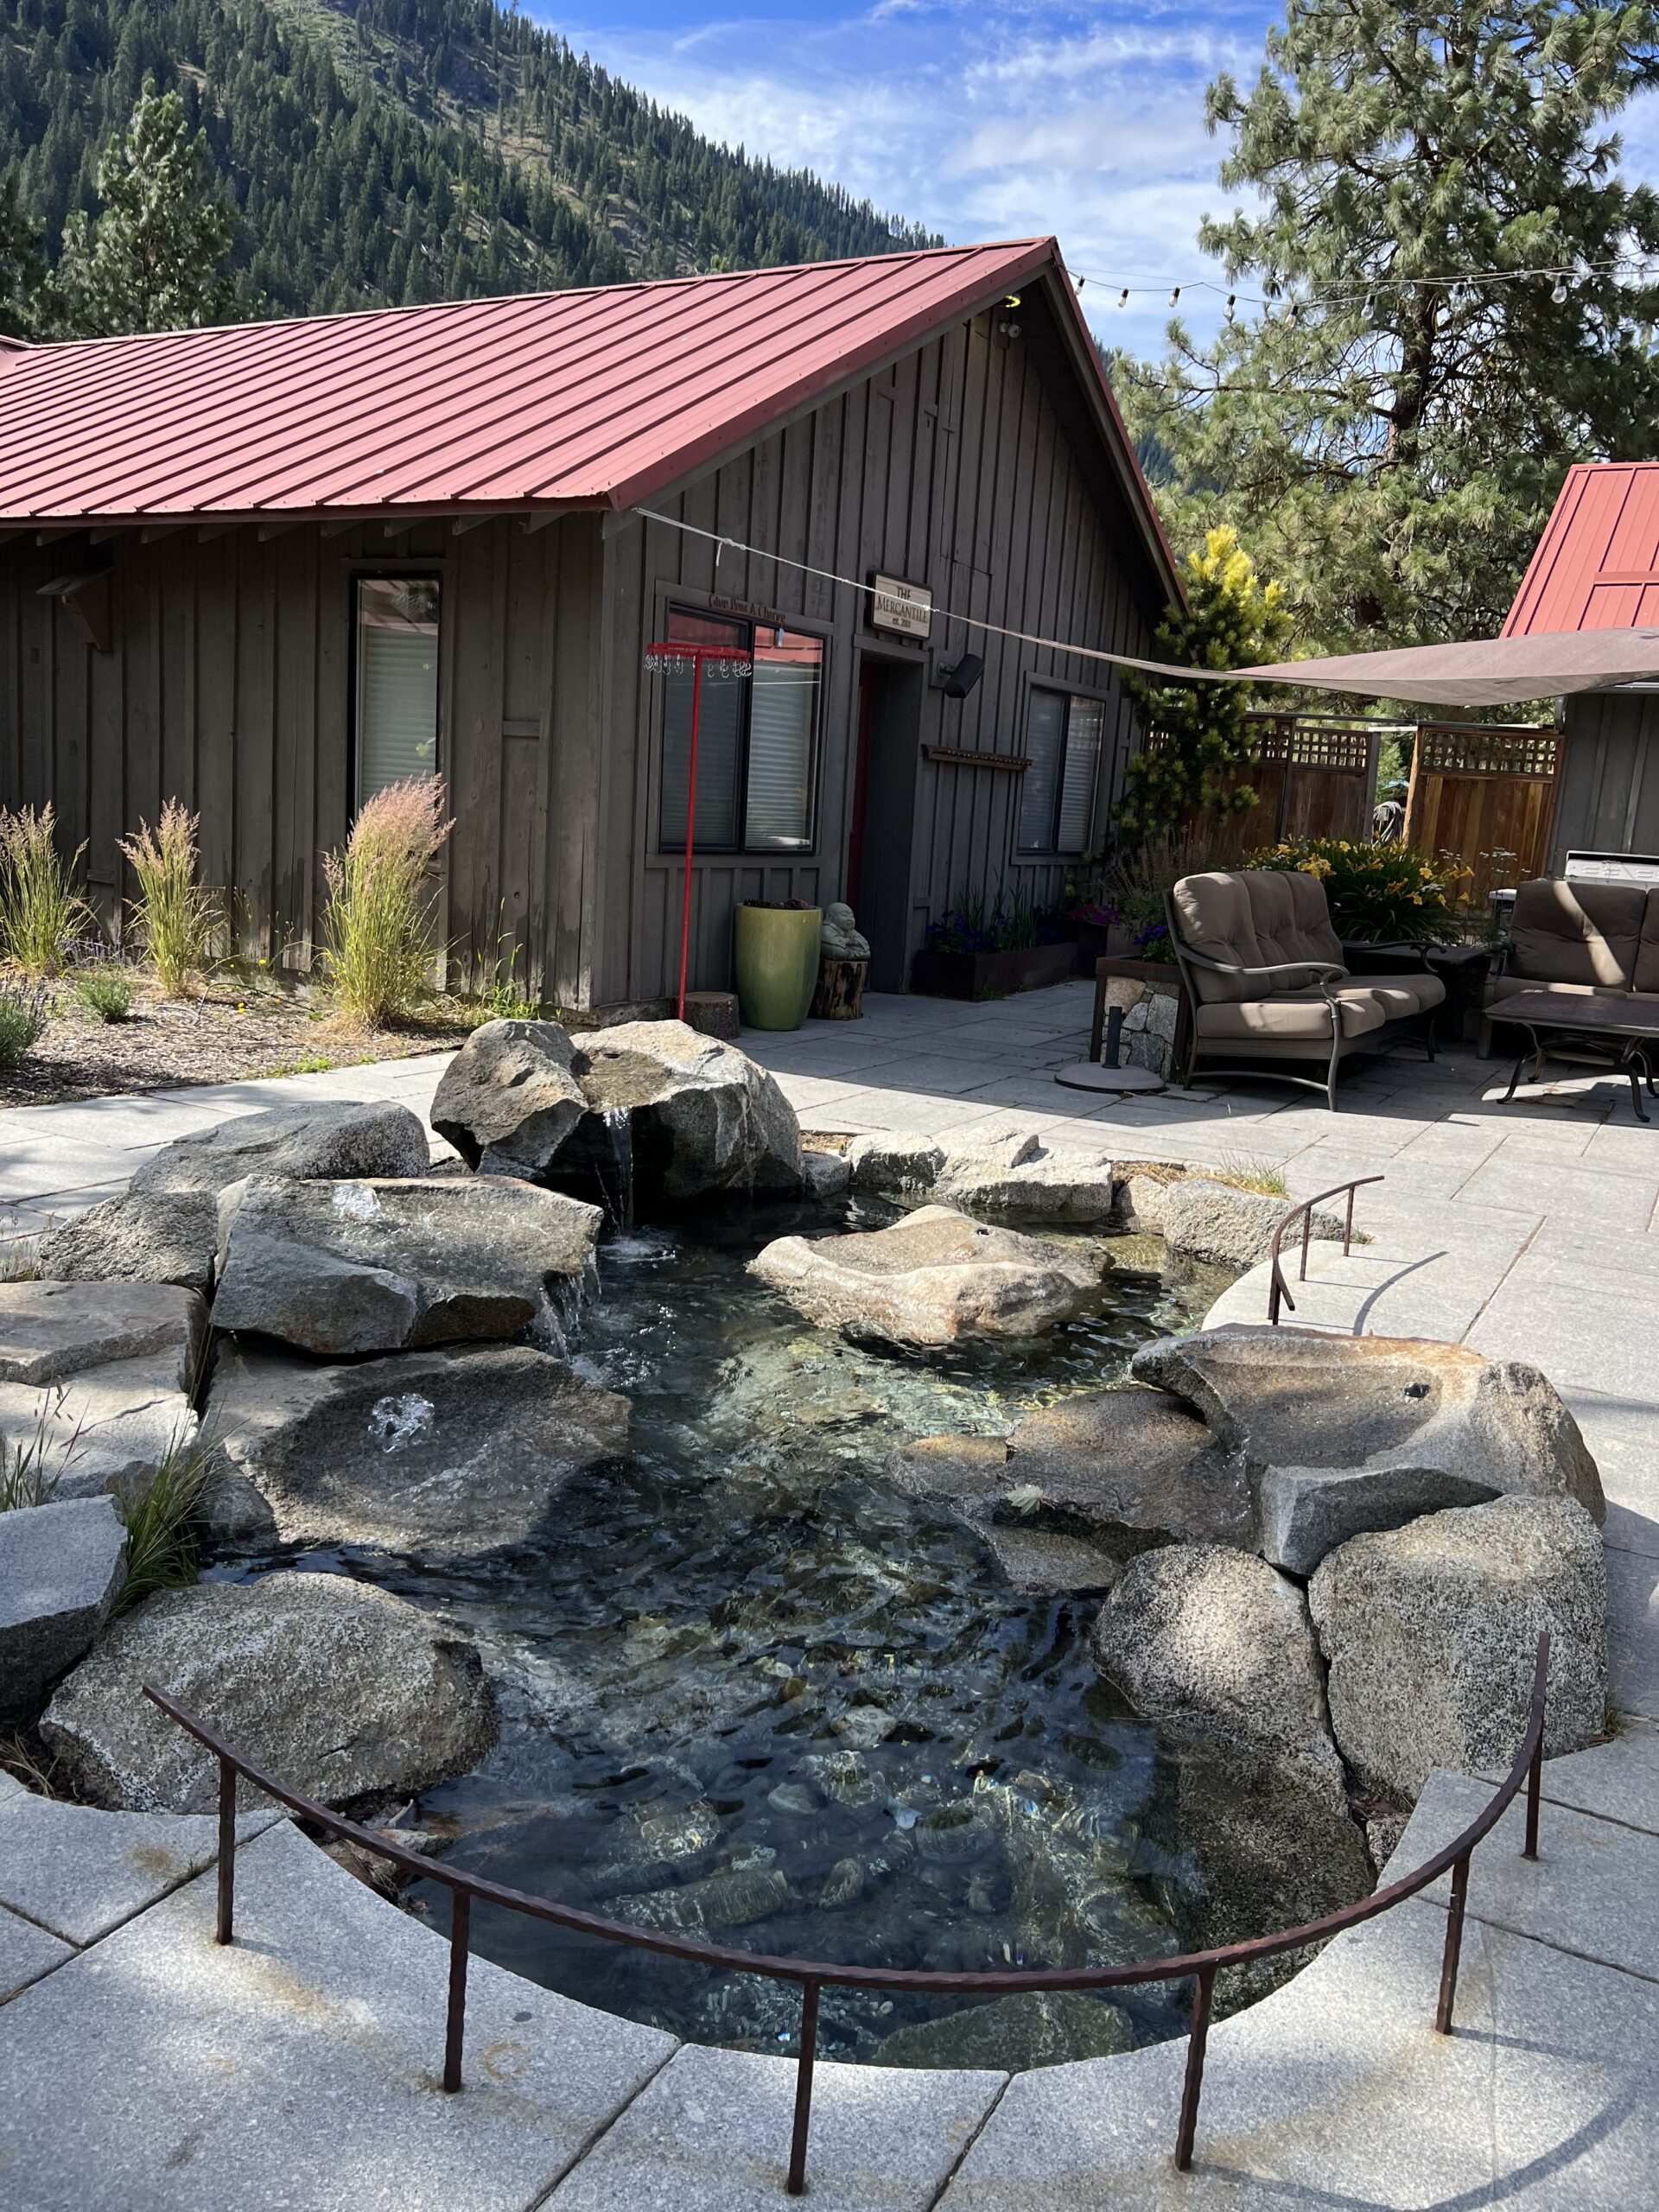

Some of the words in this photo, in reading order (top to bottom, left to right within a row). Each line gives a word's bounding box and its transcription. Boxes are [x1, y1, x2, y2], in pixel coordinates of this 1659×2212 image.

[709, 593, 728, 608] Give
[750, 601, 756, 614] A
[897, 586, 912, 600] THE
[875, 595, 928, 623] MERCANTILE
